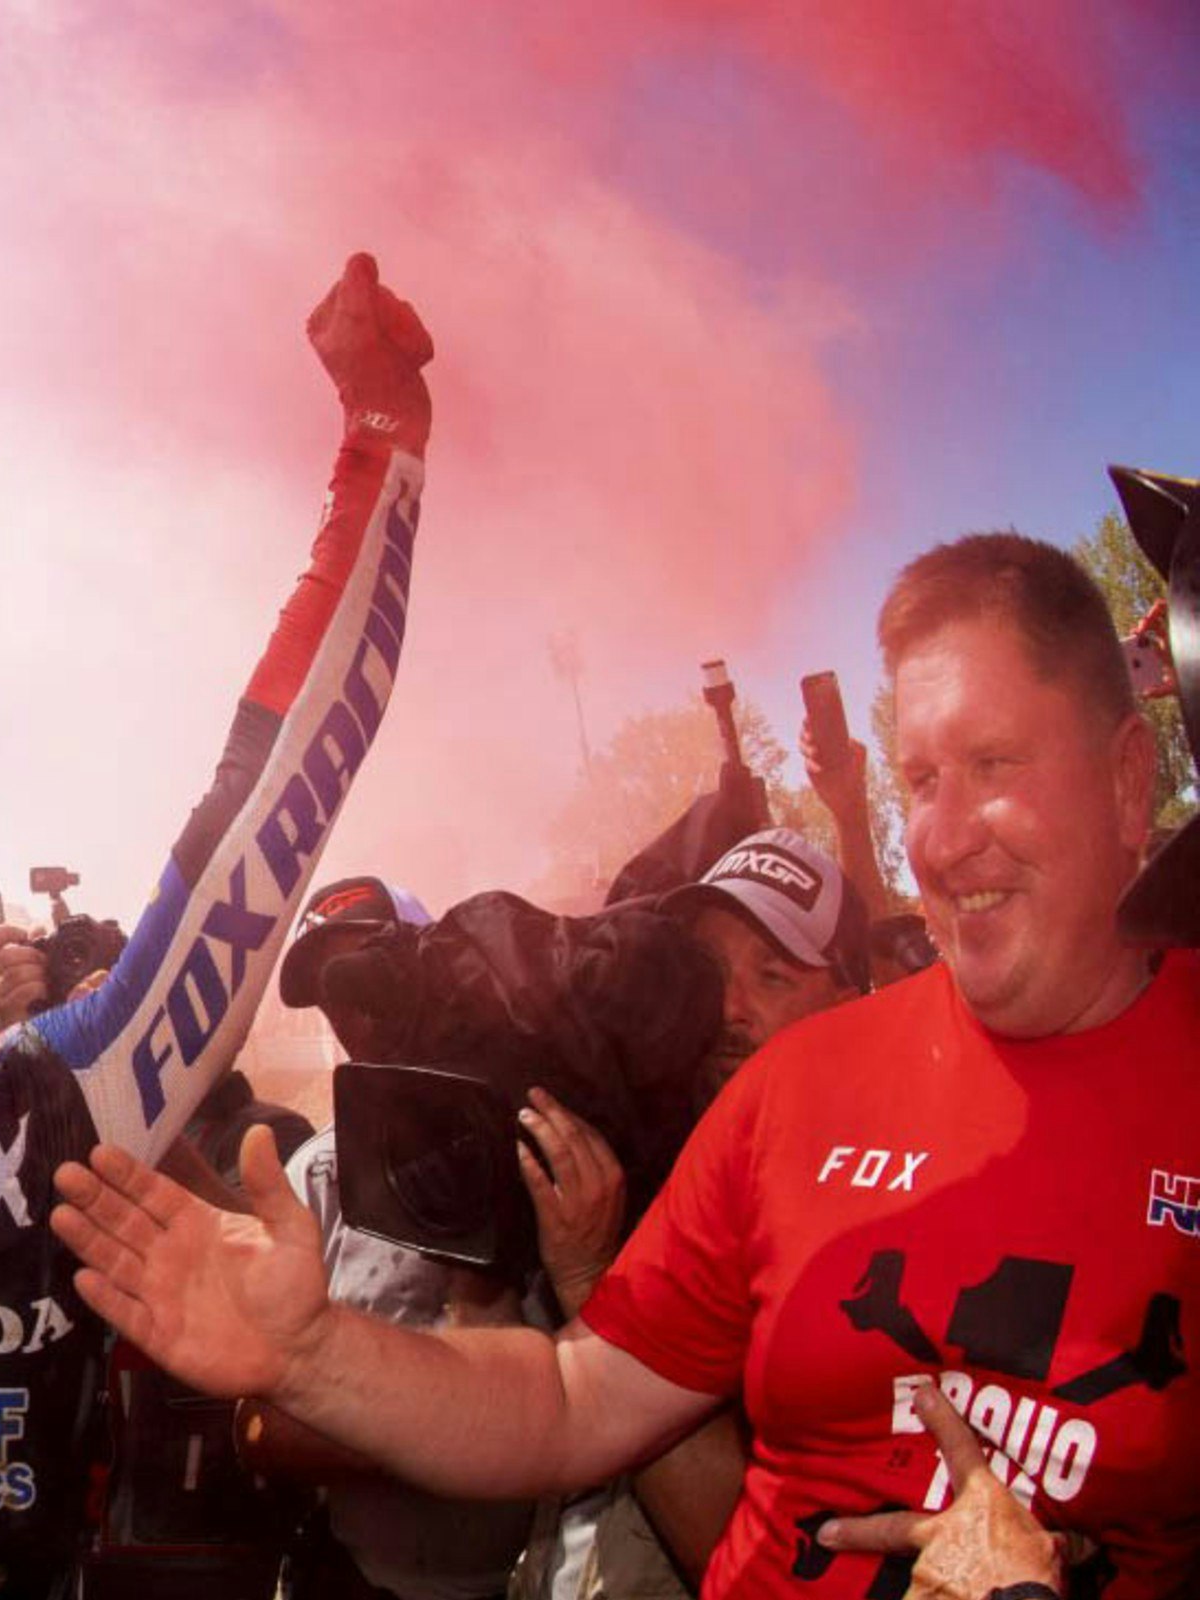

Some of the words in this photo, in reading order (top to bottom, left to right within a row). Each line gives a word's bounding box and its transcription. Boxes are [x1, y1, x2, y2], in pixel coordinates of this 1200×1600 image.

[716, 849, 817, 892] MXGP
[131, 852, 278, 1131] FOX
[817, 1146, 930, 1192] FOX
